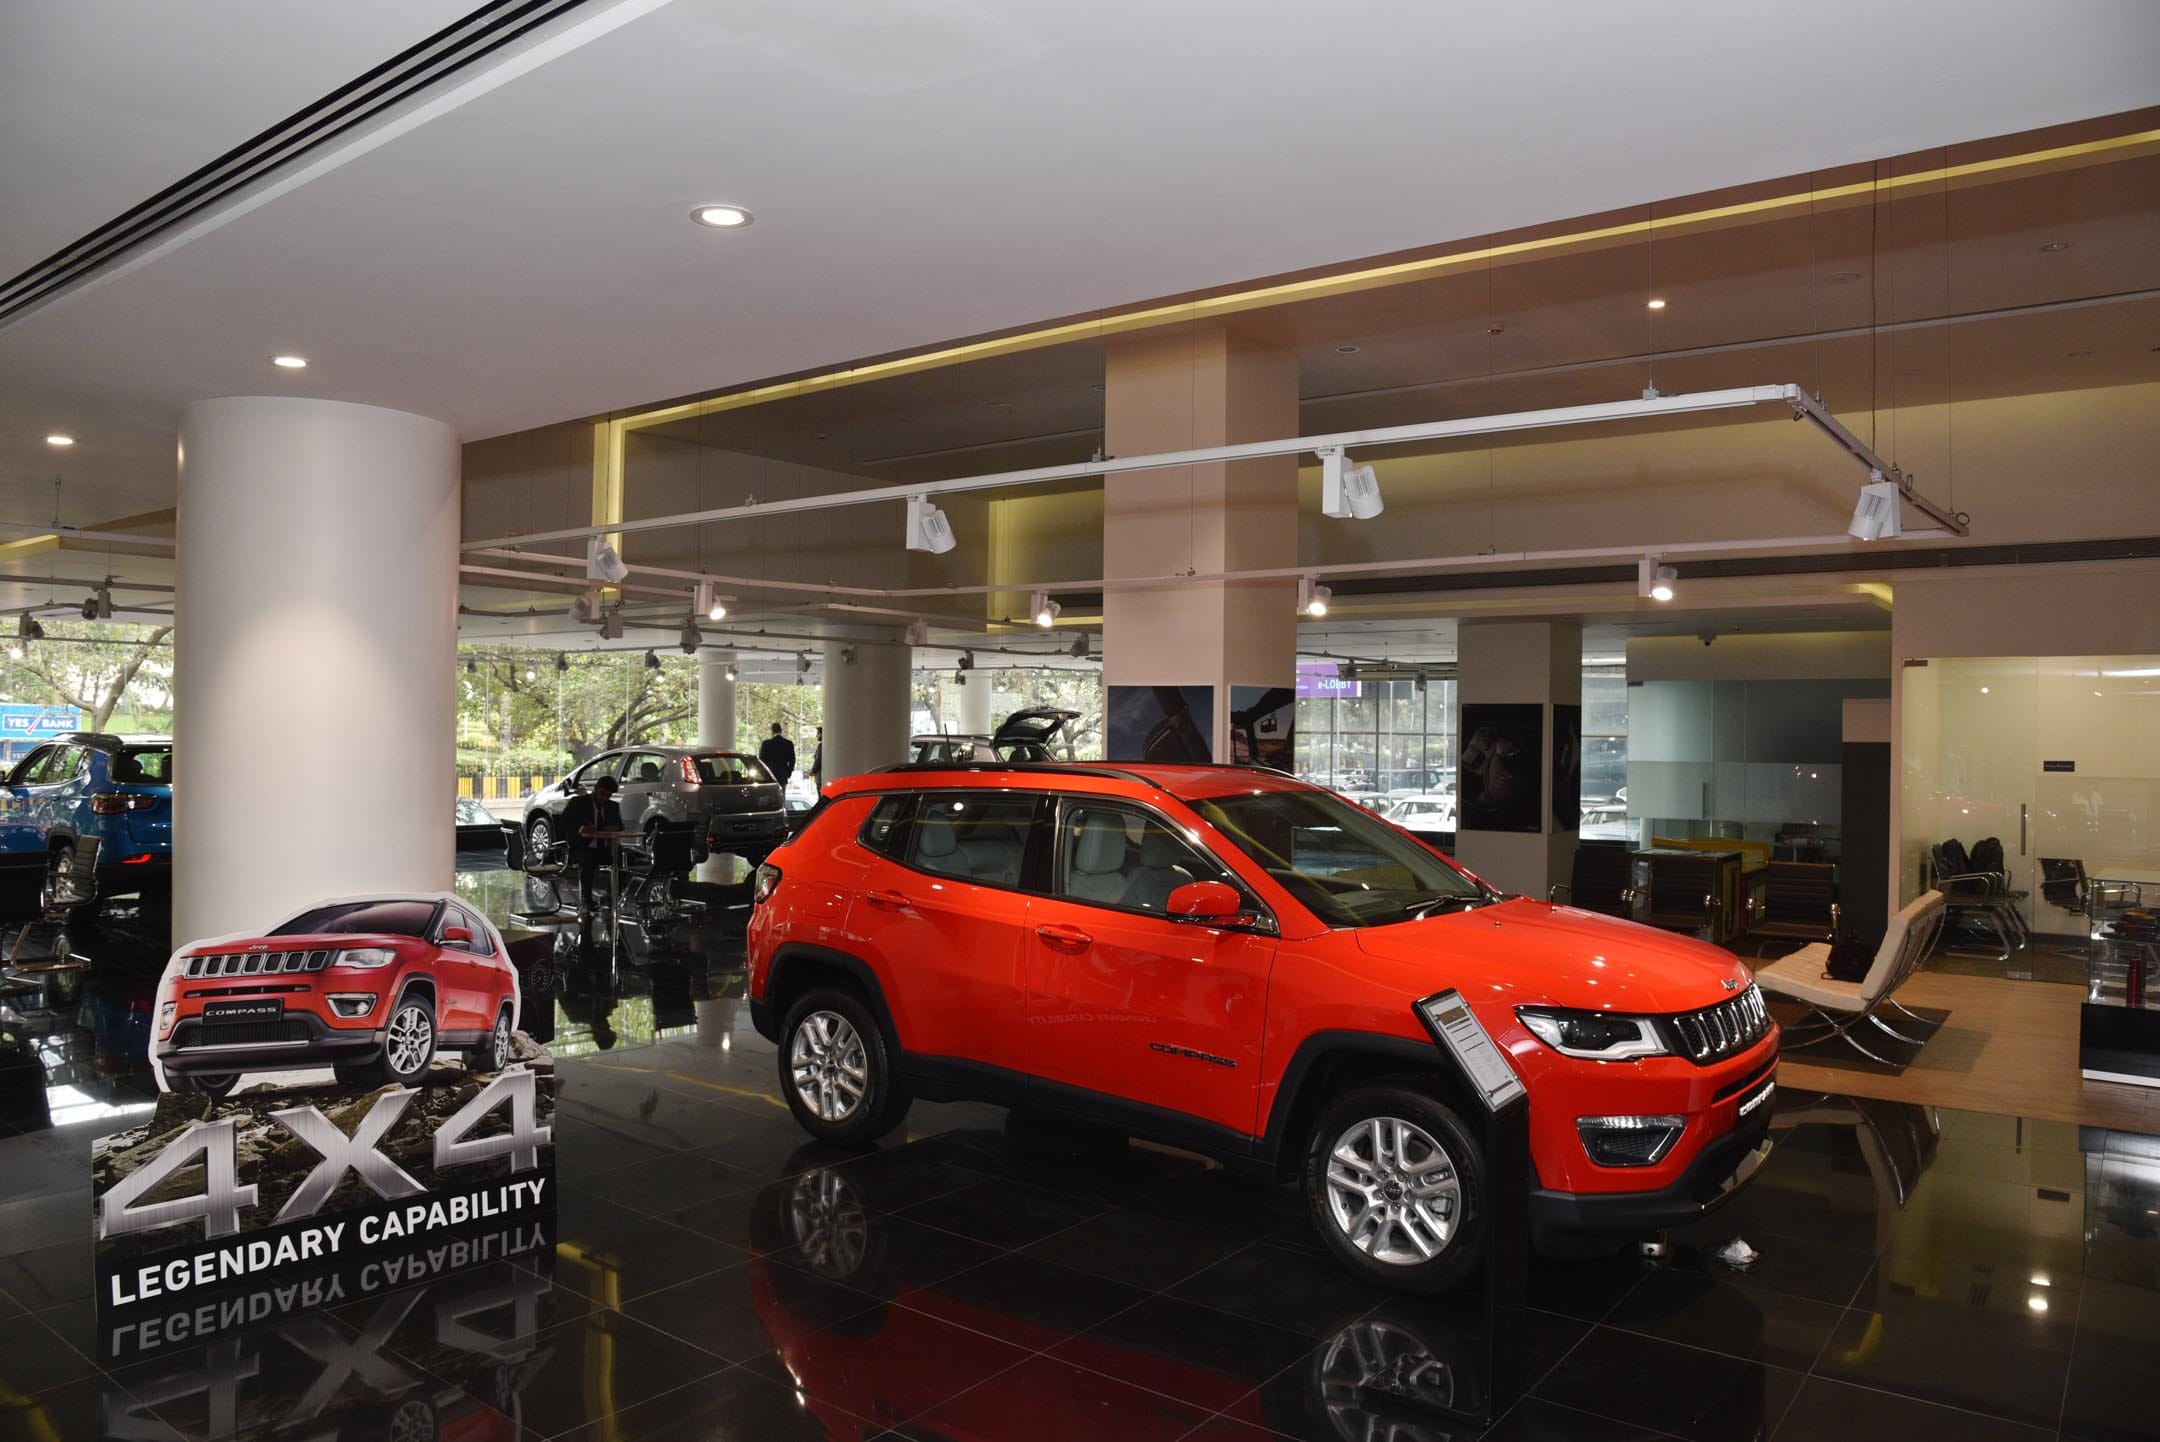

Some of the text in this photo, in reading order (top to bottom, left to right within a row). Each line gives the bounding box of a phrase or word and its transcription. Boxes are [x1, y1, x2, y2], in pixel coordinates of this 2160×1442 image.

[8, 718, 74, 729] YES BANK
[206, 1006, 277, 1017] COMPASS
[99, 1069, 552, 1242] 4X4
[111, 1178, 547, 1307] LEGENDARY CAPABILITY
